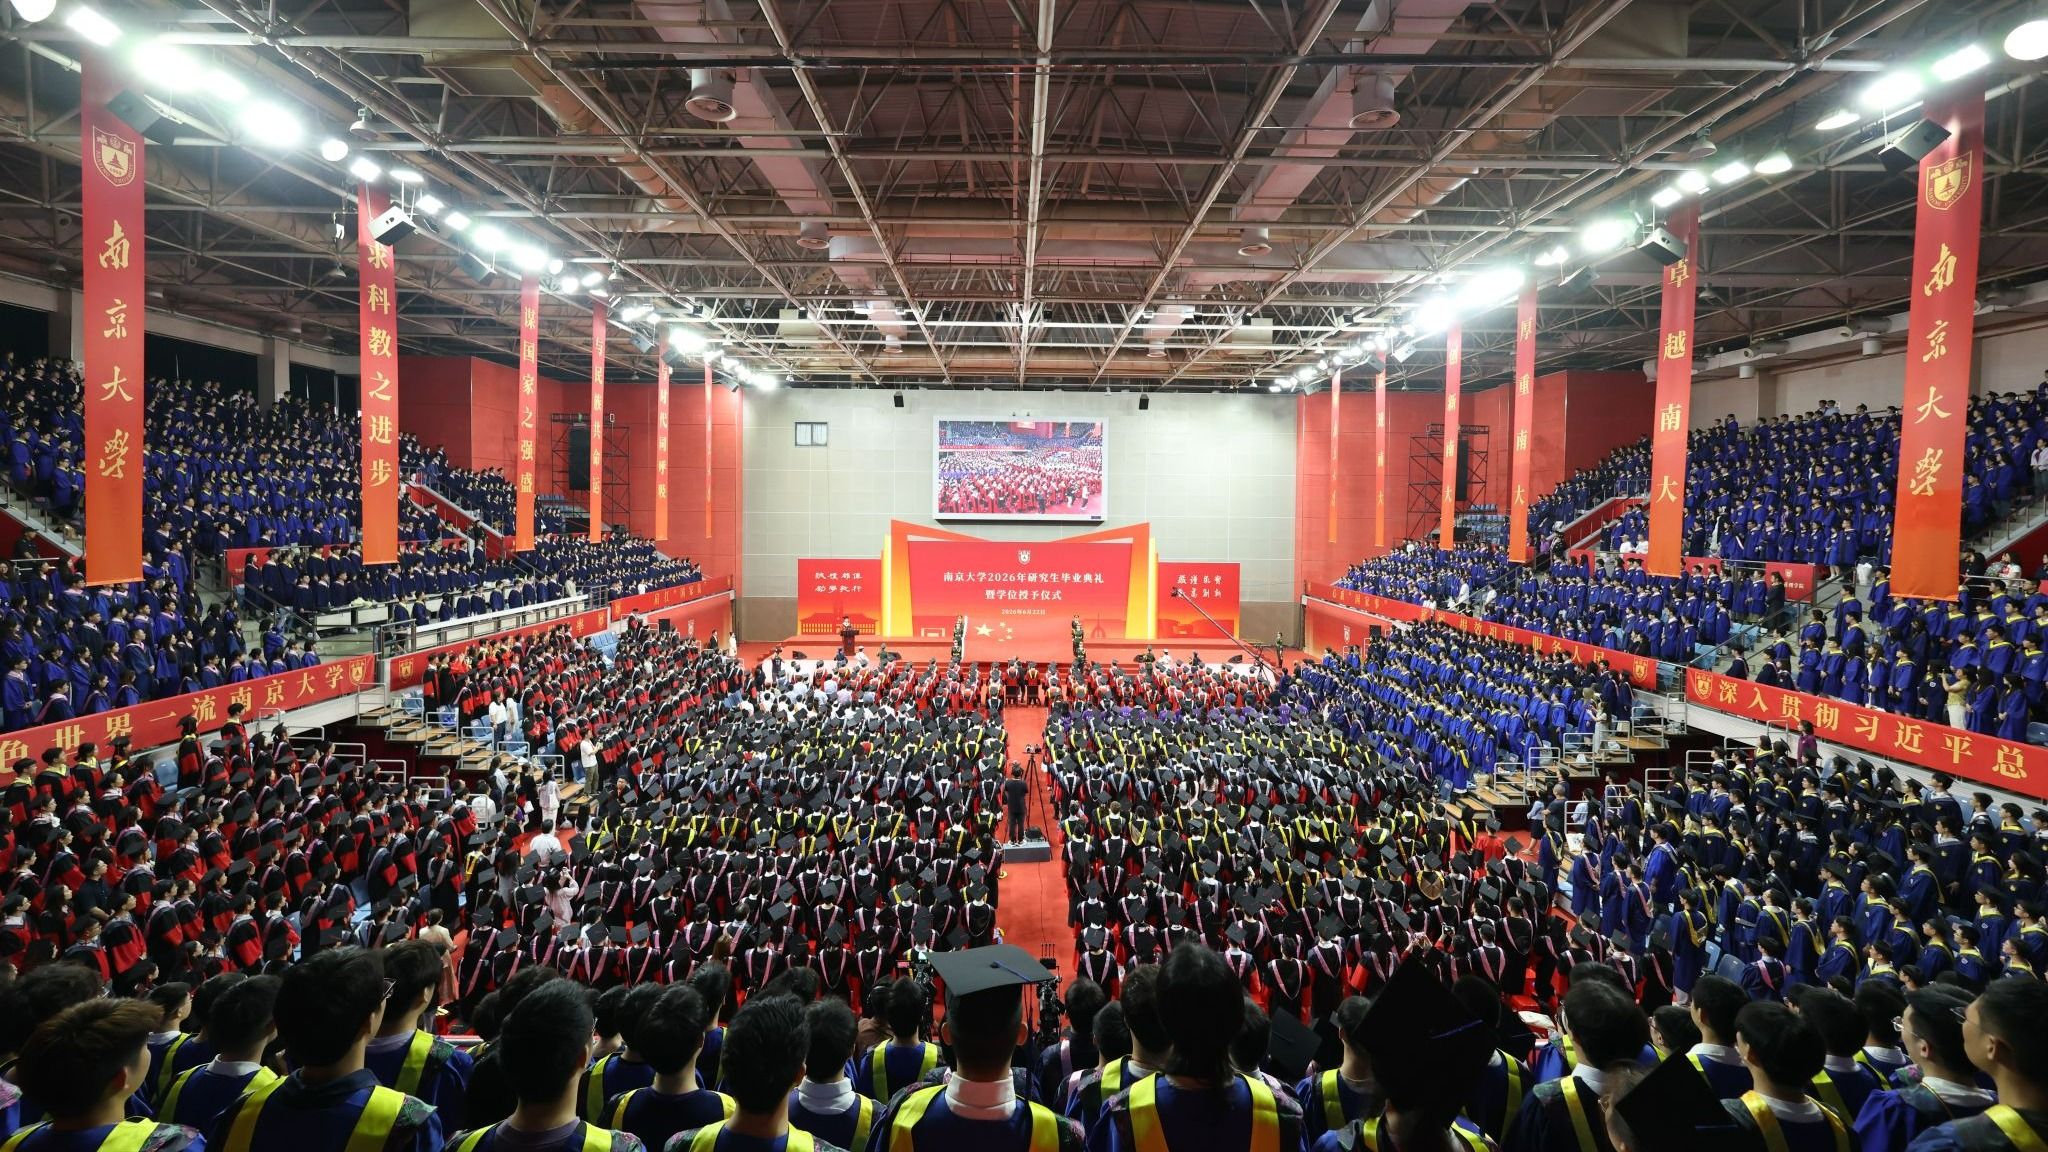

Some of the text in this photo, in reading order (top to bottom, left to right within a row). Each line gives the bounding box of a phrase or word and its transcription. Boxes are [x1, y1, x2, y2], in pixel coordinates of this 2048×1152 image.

[367, 239, 392, 487] 求科教之进步
[520, 306, 536, 493] 谋国家之强盛
[591, 336, 604, 495] 与民族共命运
[657, 363, 670, 499] 与时代同呼吸
[1514, 317, 1533, 505] 厚重南大
[1656, 257, 1689, 504] 卓越南大
[943, 571, 1104, 584] 南京大学2026年研究生毕业典礼
[985, 589, 1062, 601] 暨学位授予仪式
[1001, 608, 1046, 616] 2026年6月22日
[1719, 678, 2028, 780] 深入贯彻习近平总
